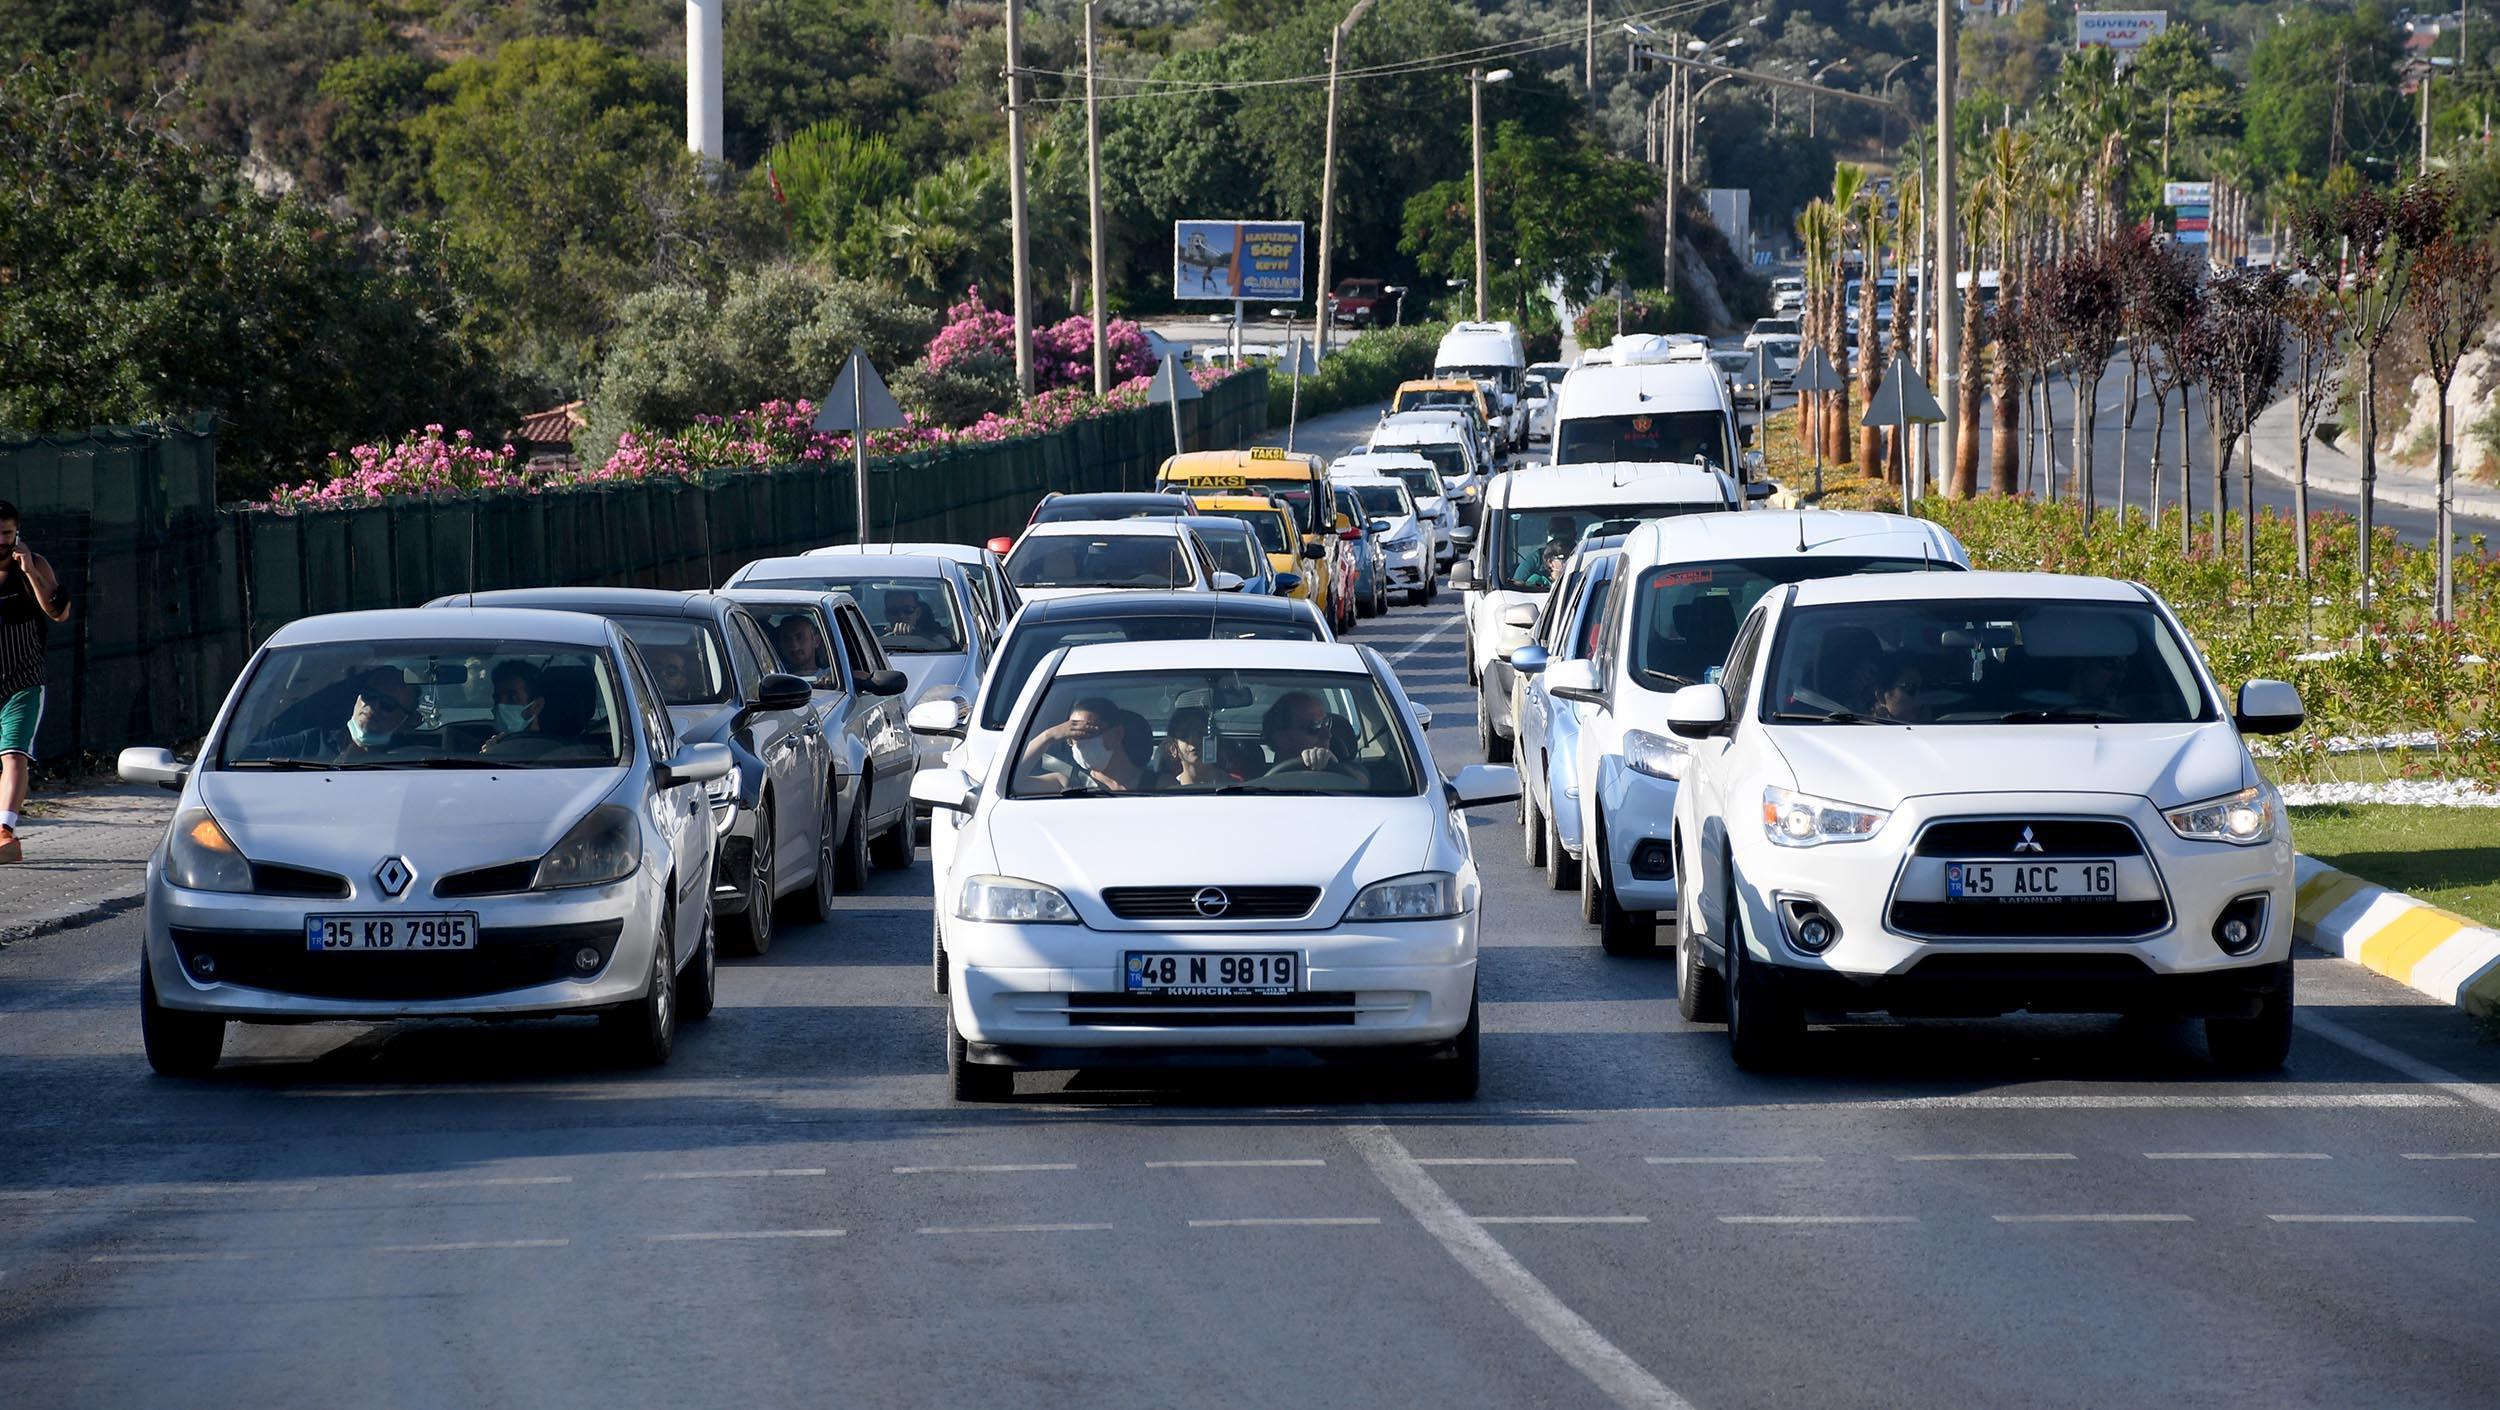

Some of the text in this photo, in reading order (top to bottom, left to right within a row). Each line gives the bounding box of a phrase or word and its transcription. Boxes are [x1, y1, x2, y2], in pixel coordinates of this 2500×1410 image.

[2106, 31, 2137, 39] GAZ
[1250, 243, 1294, 257] SÖRF
[1965, 866, 2110, 893] 45 ACC 16
[1951, 883, 1962, 891] TR
[324, 921, 466, 947] 35 KB 7995
[1142, 957, 1290, 984] 48 N 9819
[1131, 974, 1141, 982] TR
[1168, 987, 1232, 996] KIVIRCIK
